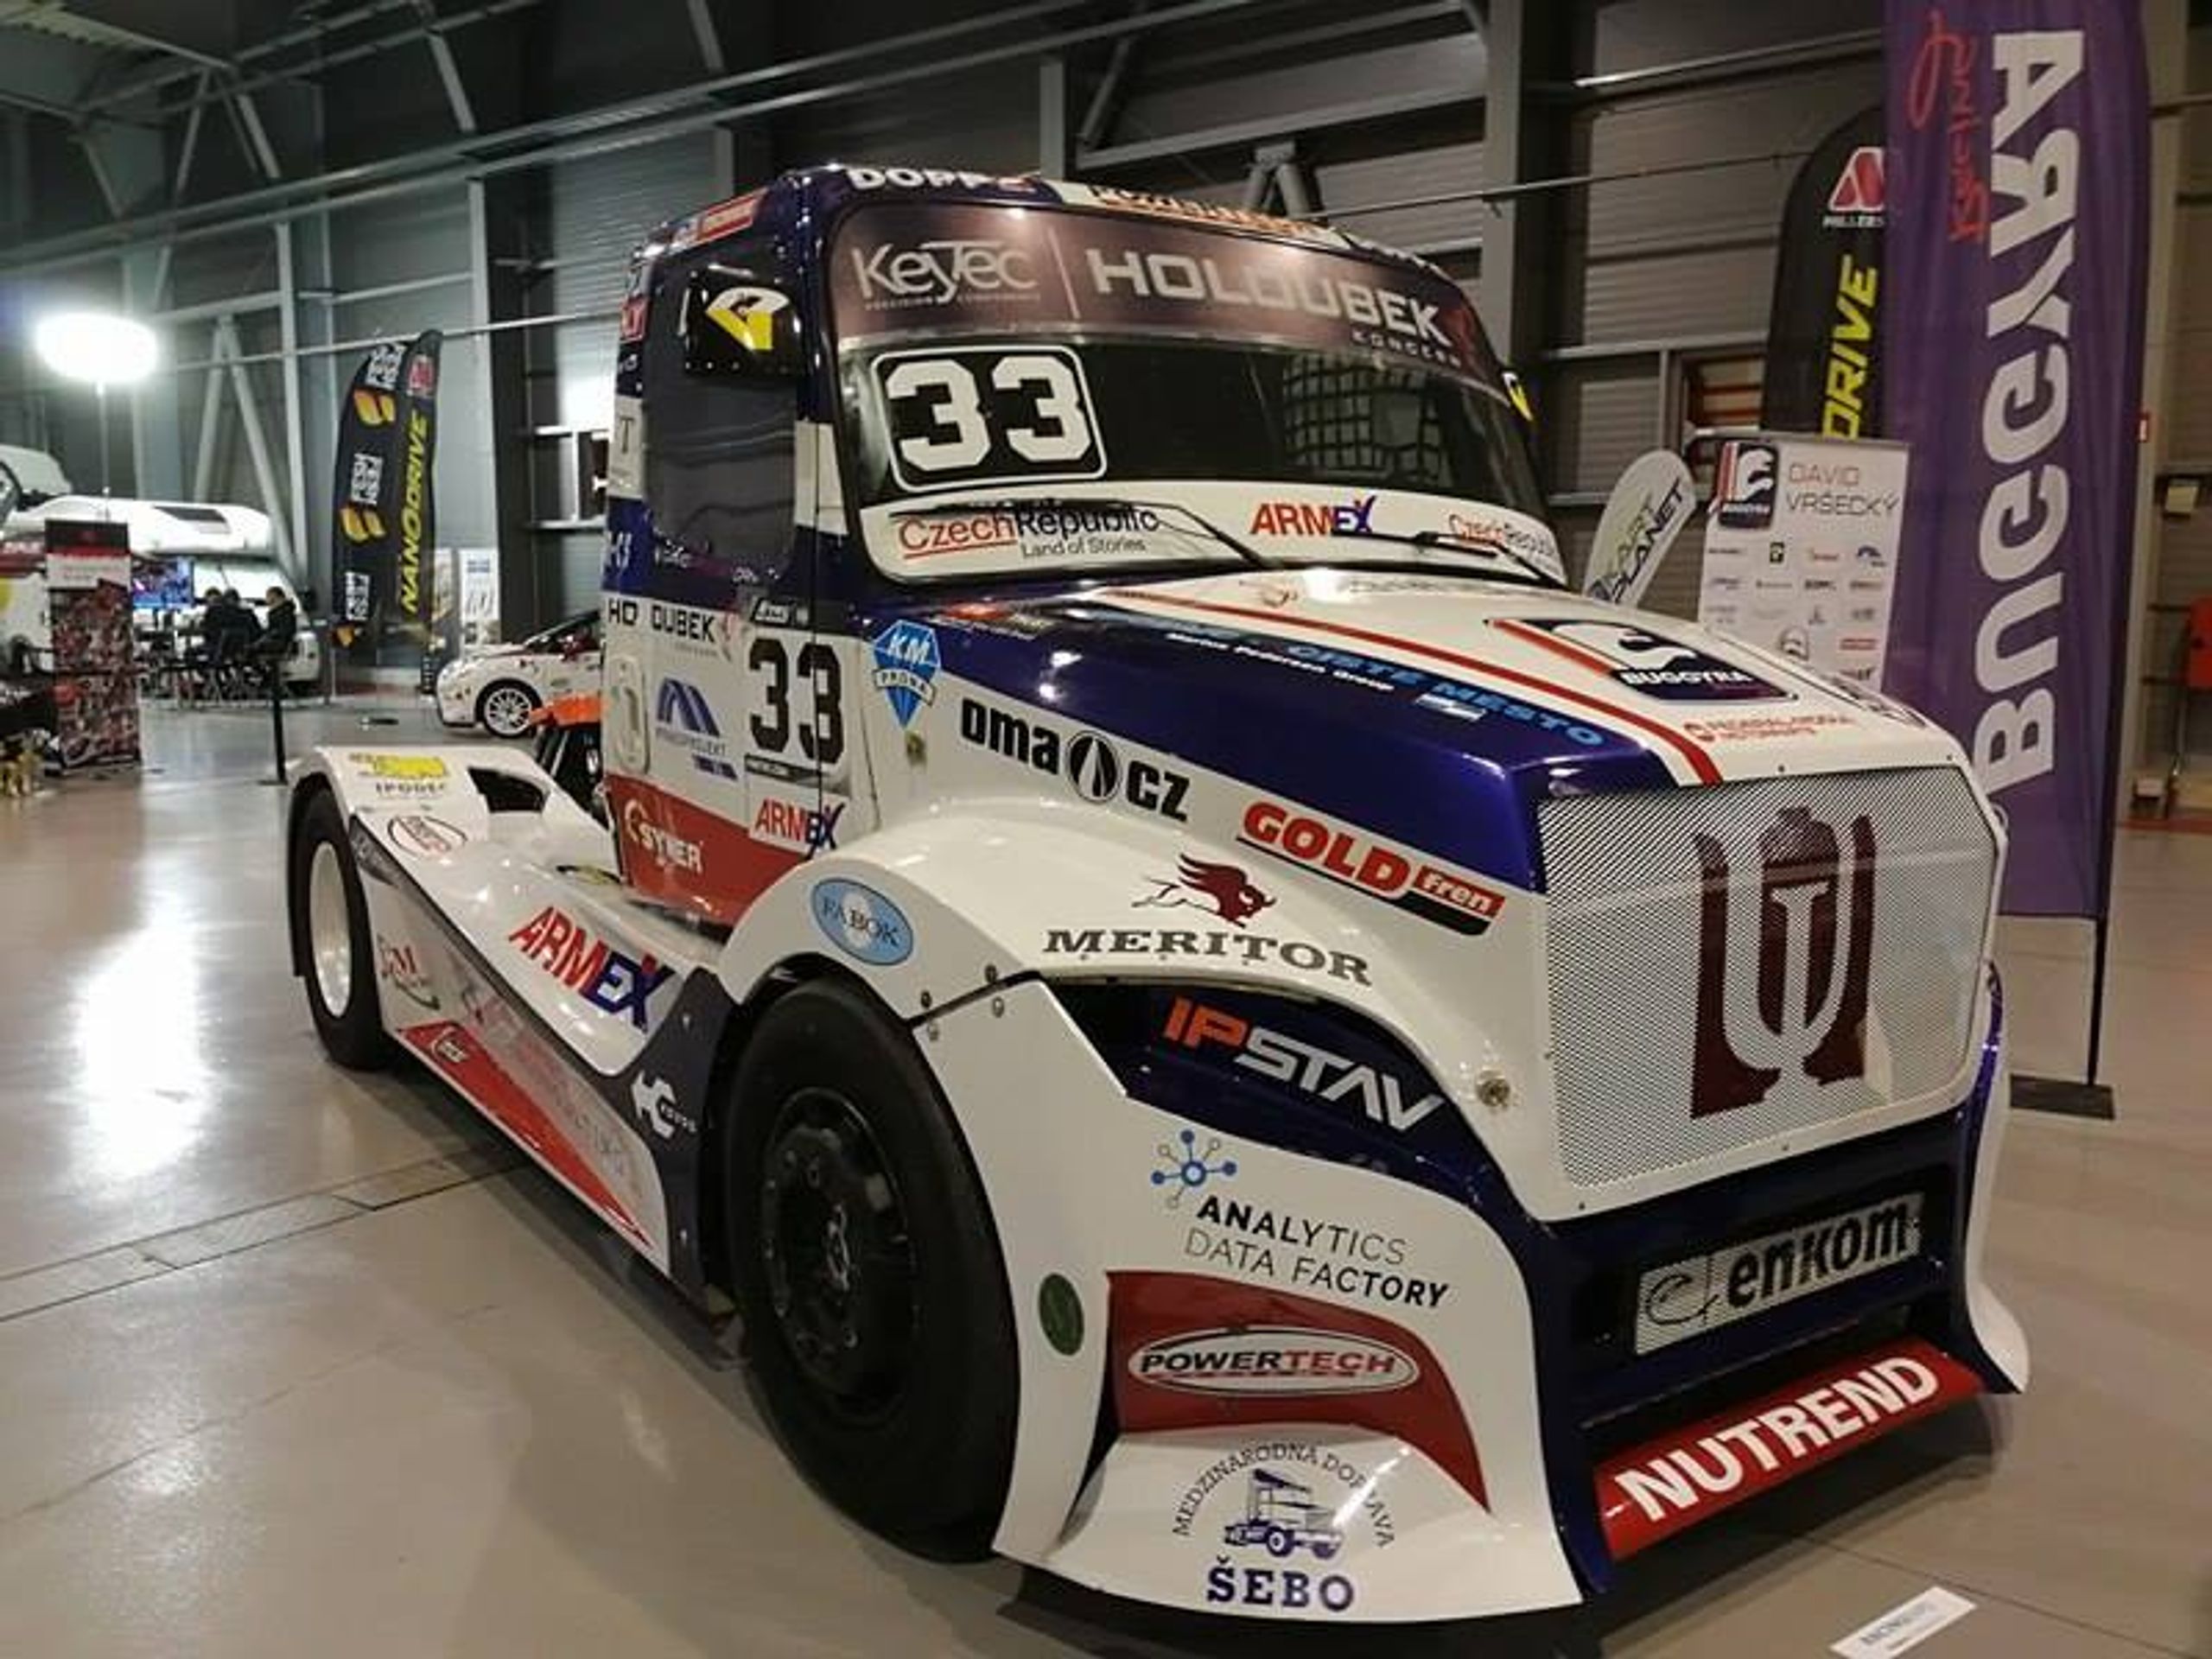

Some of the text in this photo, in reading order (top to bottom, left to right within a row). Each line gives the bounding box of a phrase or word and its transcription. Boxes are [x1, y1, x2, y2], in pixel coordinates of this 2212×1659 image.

[1084, 246, 1453, 347] HOLOUBEK
[885, 354, 1094, 472] 33
[1250, 495, 1377, 536] ARMEX
[1789, 463, 1859, 486] DAVID
[1021, 536, 1147, 558] Land of Stories
[749, 638, 845, 765] 33
[1125, 760, 1192, 823] CZ
[1242, 802, 1411, 894] GOLD
[508, 906, 676, 1034] ARMEX
[1042, 929, 1373, 988] MERITOR
[1163, 996, 1446, 1132] IPSTAV
[1185, 1228, 1452, 1310] DATA FACTORY
[1197, 1195, 1408, 1265] ANALYTICS
[1728, 1200, 1910, 1310] enkom
[1139, 1348, 1398, 1376] POWERTECH
[1614, 1357, 1941, 1522] NUTREND
[1322, 1452, 1395, 1548] DOPAVA
[1206, 1554, 1355, 1612] ŠEBO
